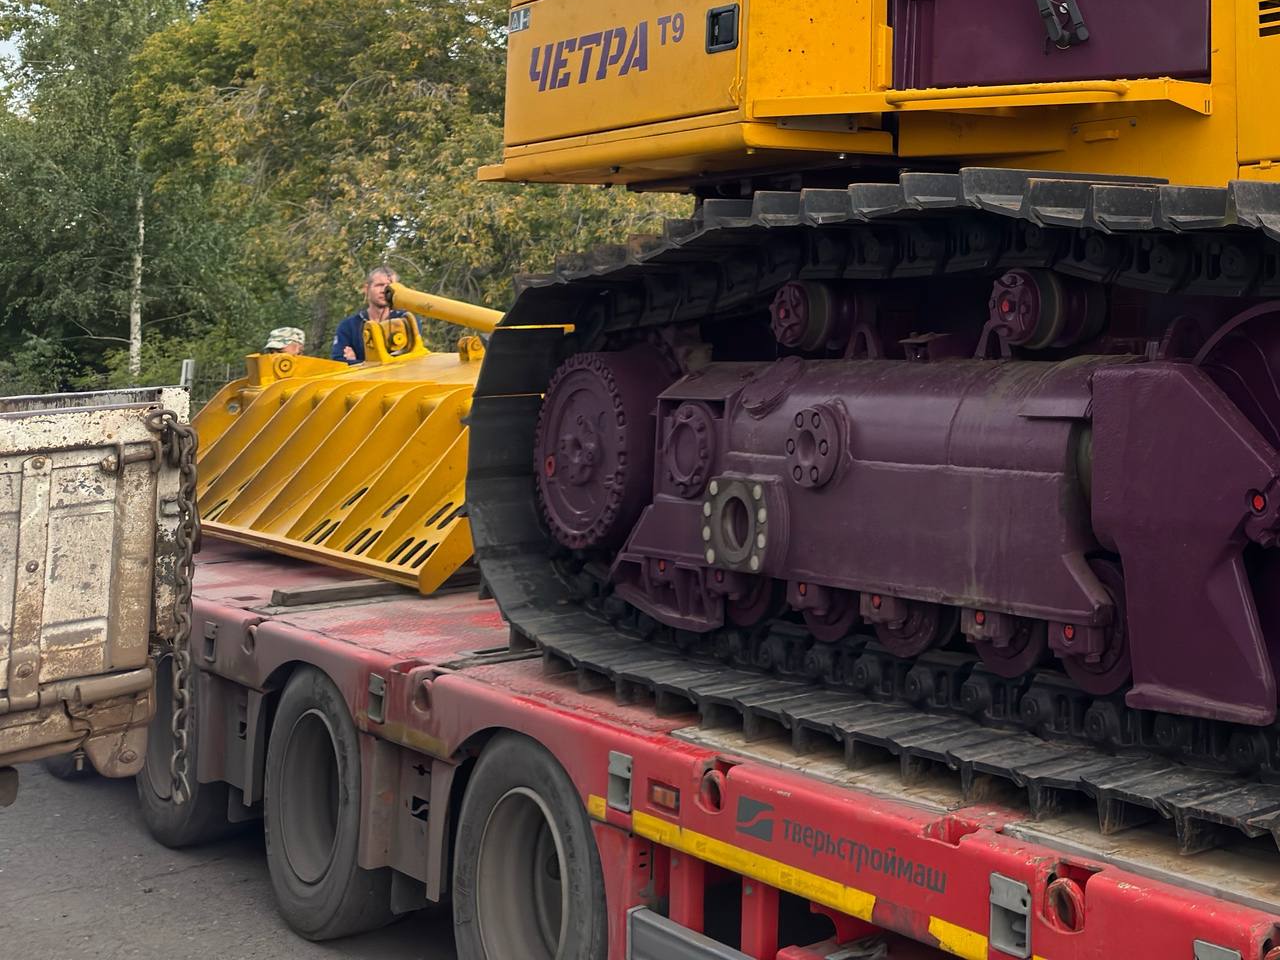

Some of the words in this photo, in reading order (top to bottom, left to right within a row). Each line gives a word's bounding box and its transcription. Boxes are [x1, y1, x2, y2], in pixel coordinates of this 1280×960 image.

[529, 21, 648, 91] ЧЕТРА
[657, 12, 685, 45] Т9
[783, 819, 948, 894] тверьстроймаш
